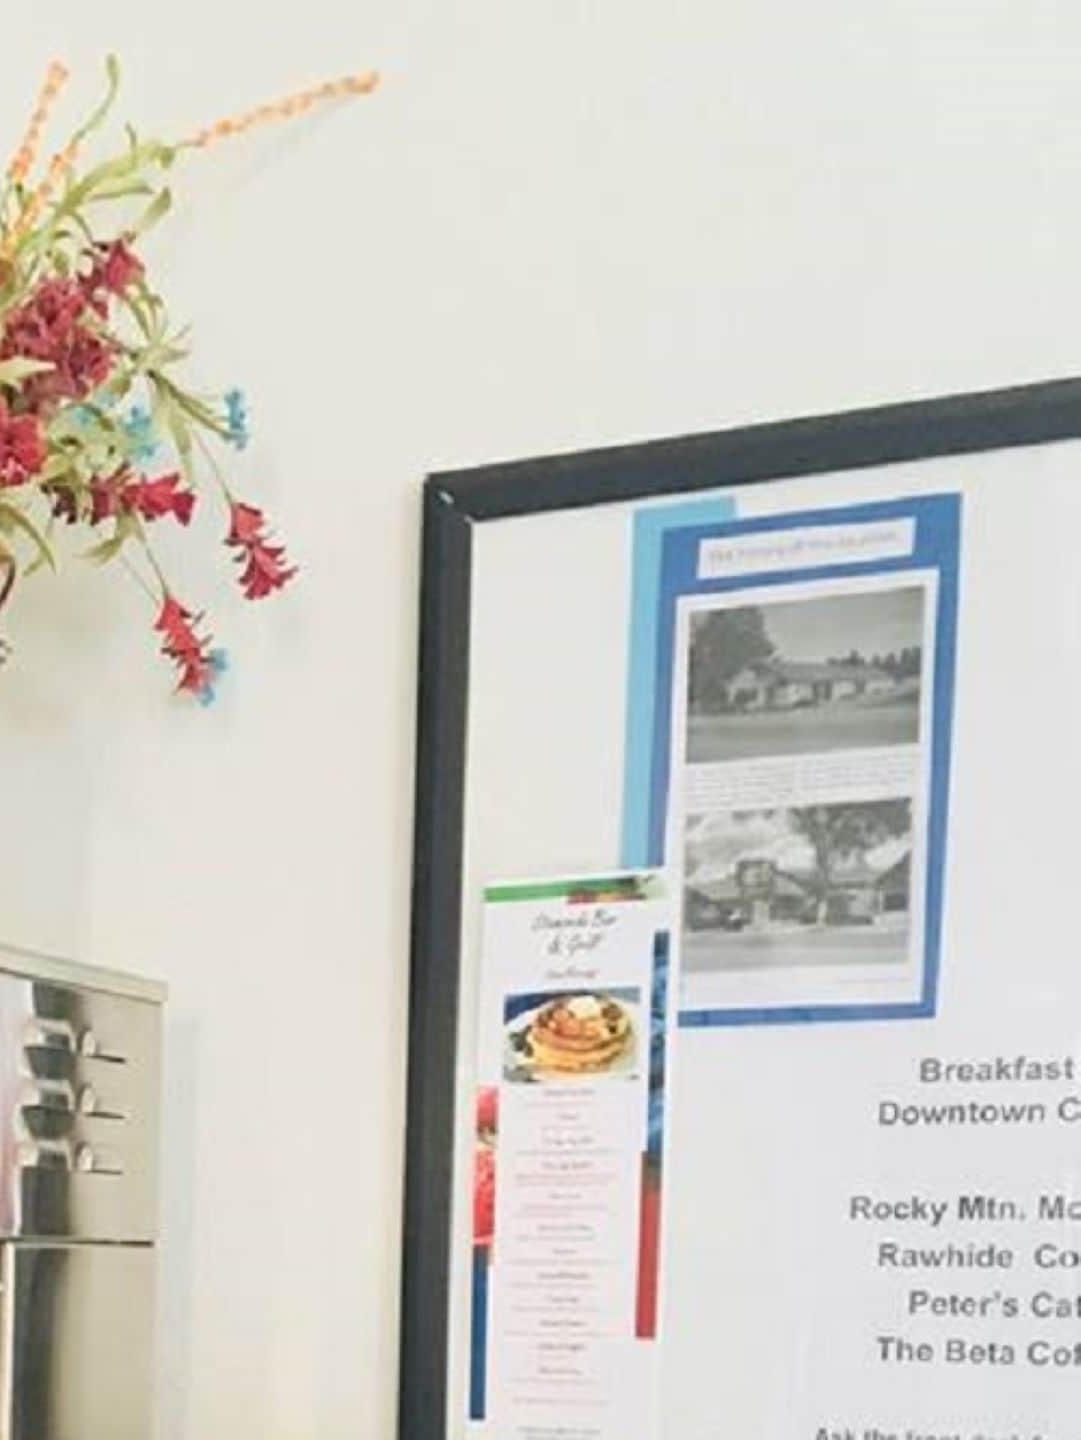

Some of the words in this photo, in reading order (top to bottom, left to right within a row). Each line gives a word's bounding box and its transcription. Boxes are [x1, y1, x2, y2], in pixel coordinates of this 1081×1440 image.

[920, 1055, 1075, 1083] Breakfast
[877, 1100, 1046, 1126] Downtown
[849, 1195, 948, 1227] Rocky
[957, 1195, 1026, 1221] Mtn.
[877, 1242, 1014, 1269] Rawhide
[908, 1289, 1019, 1318] Peter's
[876, 1335, 934, 1362] The
[945, 1338, 1015, 1365] Beta
